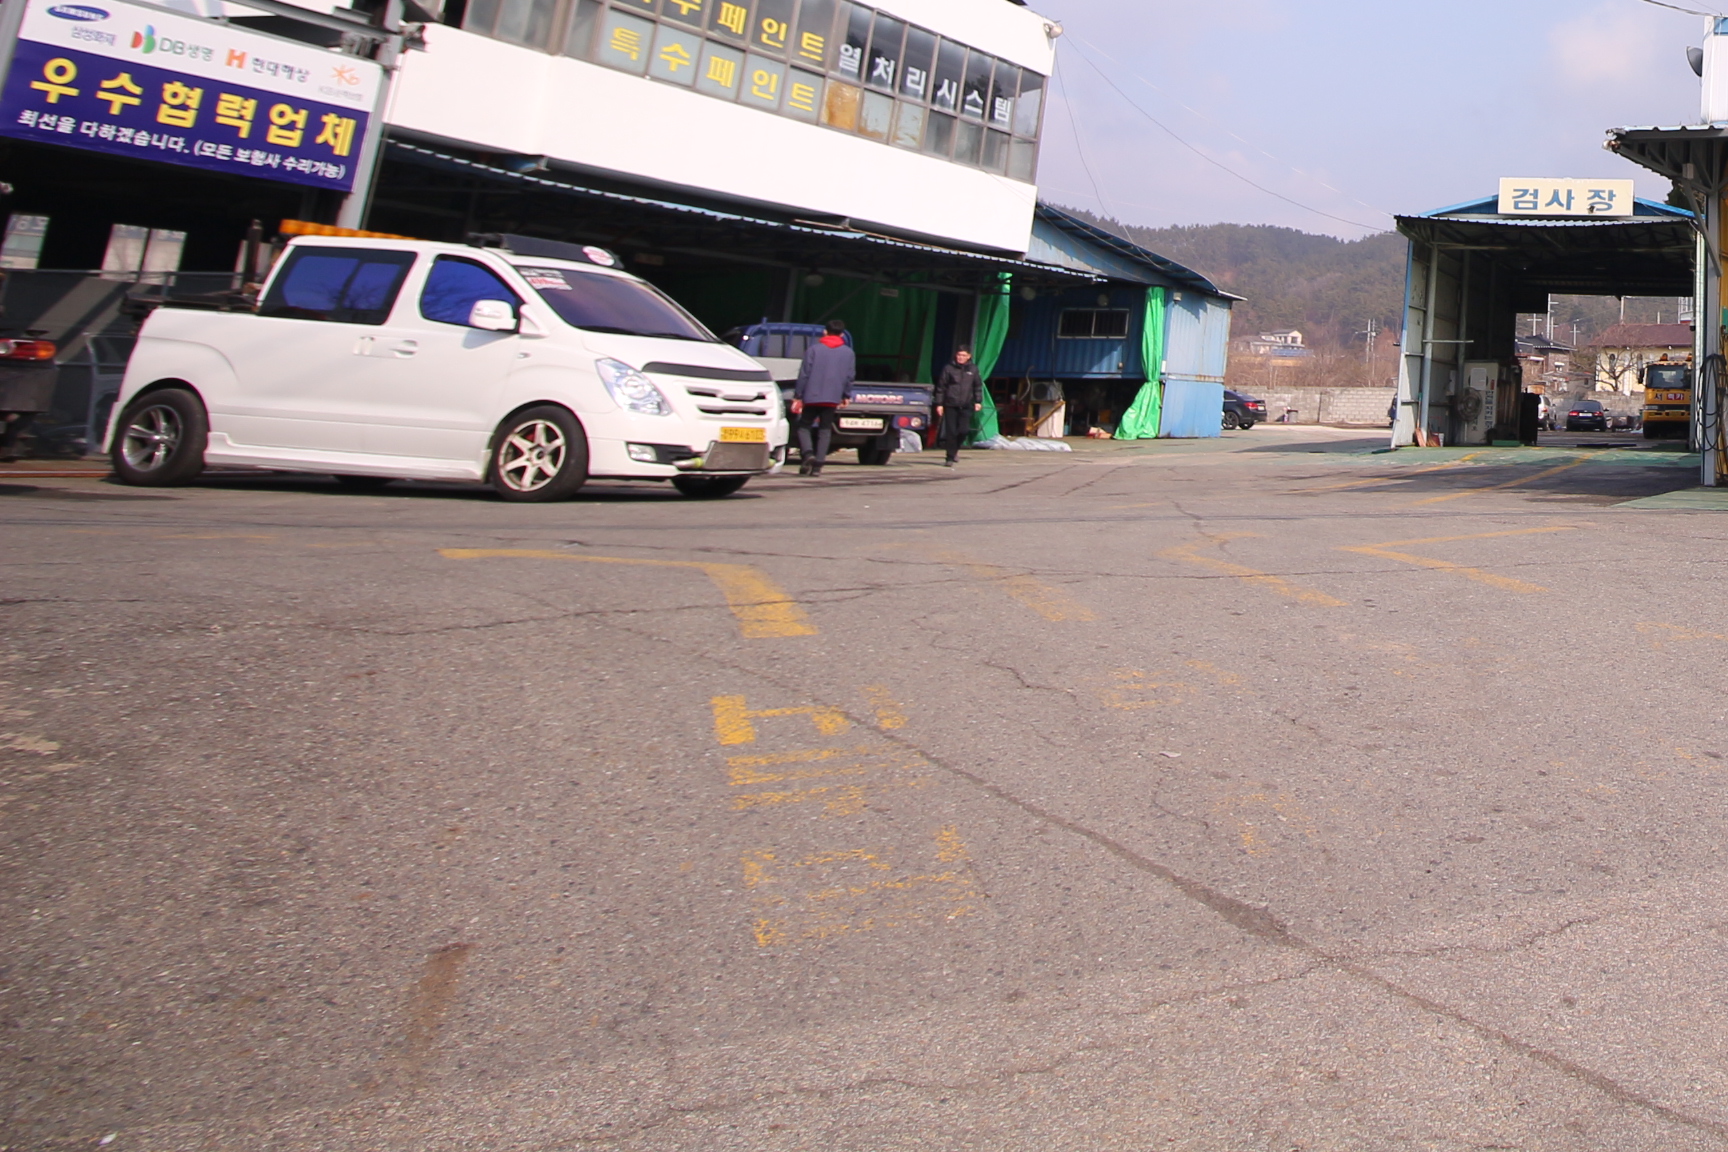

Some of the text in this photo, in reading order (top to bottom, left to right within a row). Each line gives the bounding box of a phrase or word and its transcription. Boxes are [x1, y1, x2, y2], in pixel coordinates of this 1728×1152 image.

[252, 57, 311, 83] 현대해상
[610, 26, 816, 112] 특수페인트
[838, 43, 1012, 123] 열처리시스템
[17, 109, 346, 180] 최선을 다하겠습니다. (모든 보험사 수리가능)
[1512, 188, 1616, 212] 검사장
